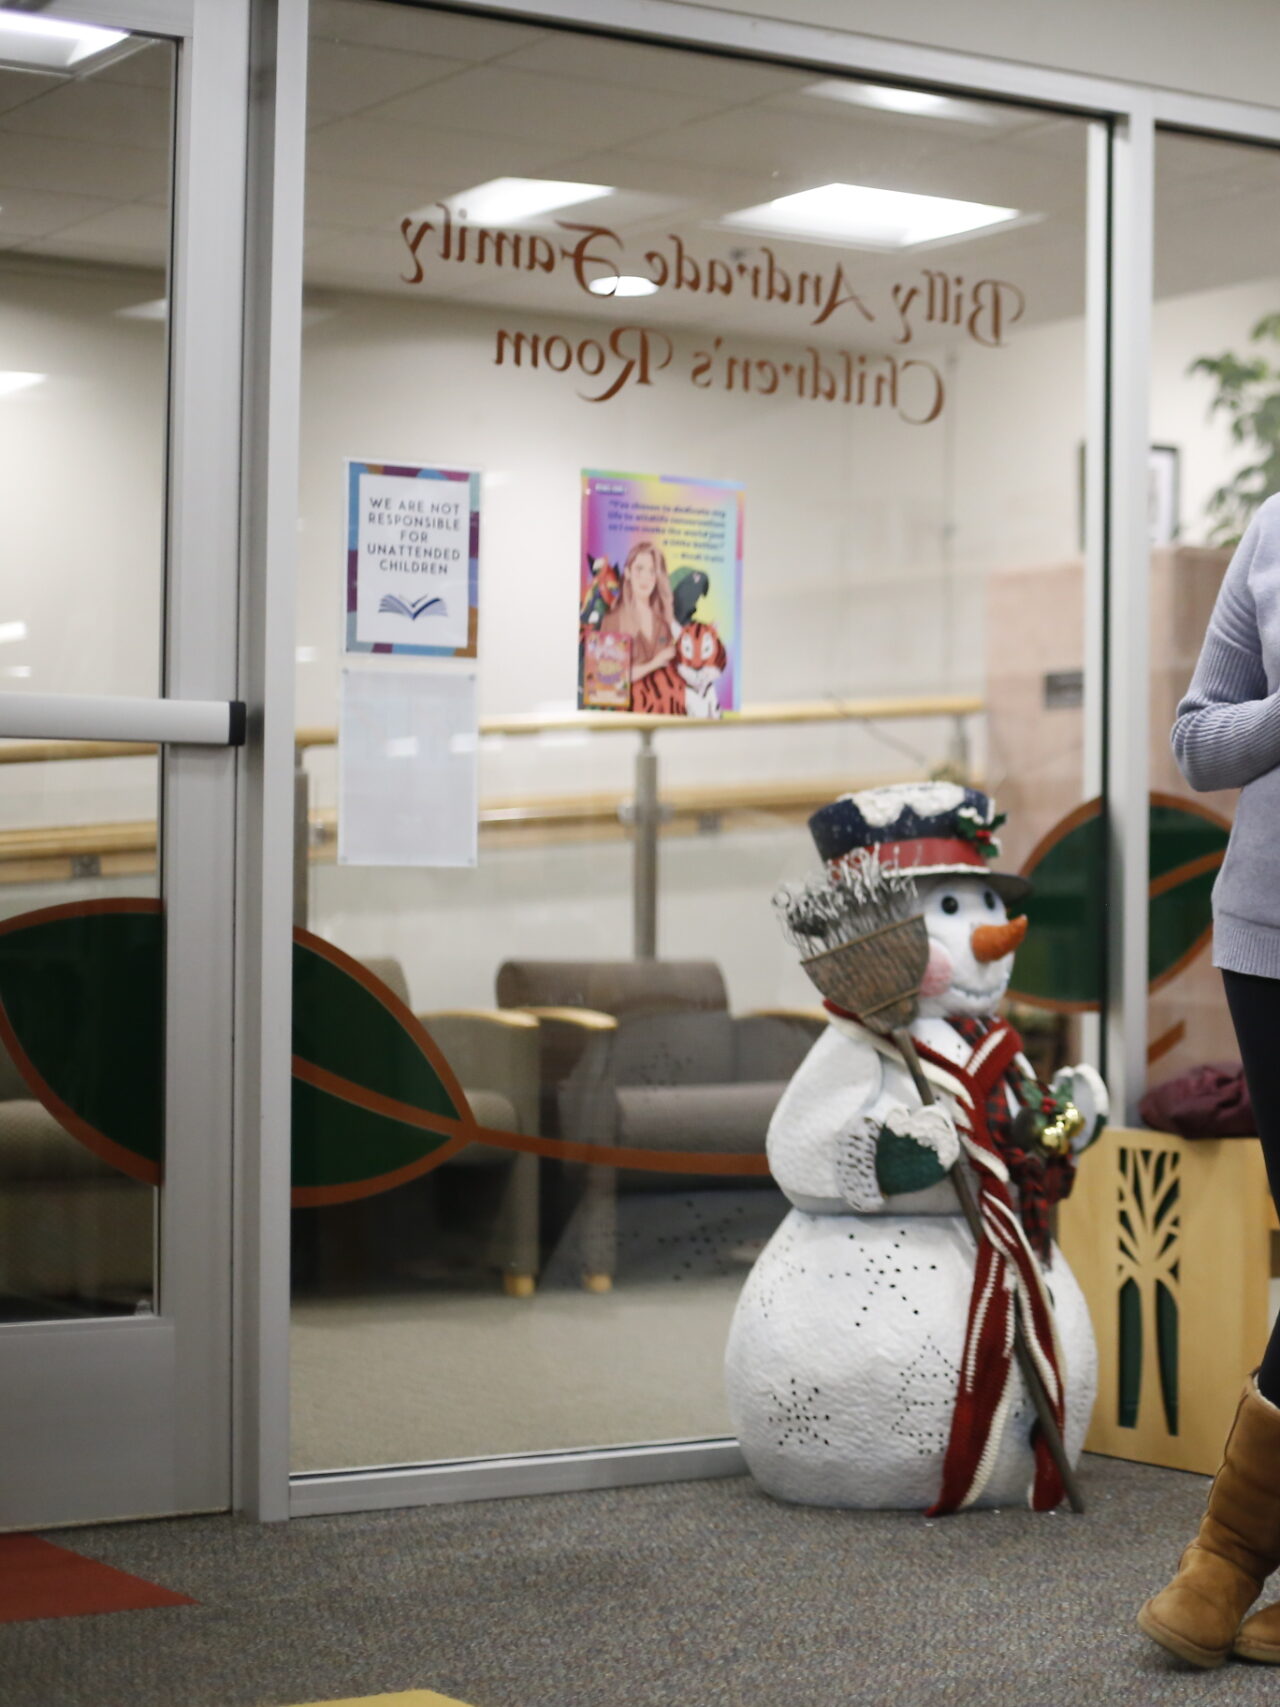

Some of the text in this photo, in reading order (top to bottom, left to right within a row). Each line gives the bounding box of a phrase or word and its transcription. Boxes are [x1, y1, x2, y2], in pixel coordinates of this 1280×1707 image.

[370, 498, 460, 515] WE ARE NOT
[368, 512, 460, 531] RESPONSIBLE
[400, 531, 428, 542] FOR
[367, 544, 460, 560] UNATTENDED
[379, 560, 448, 574] CHILDREN
